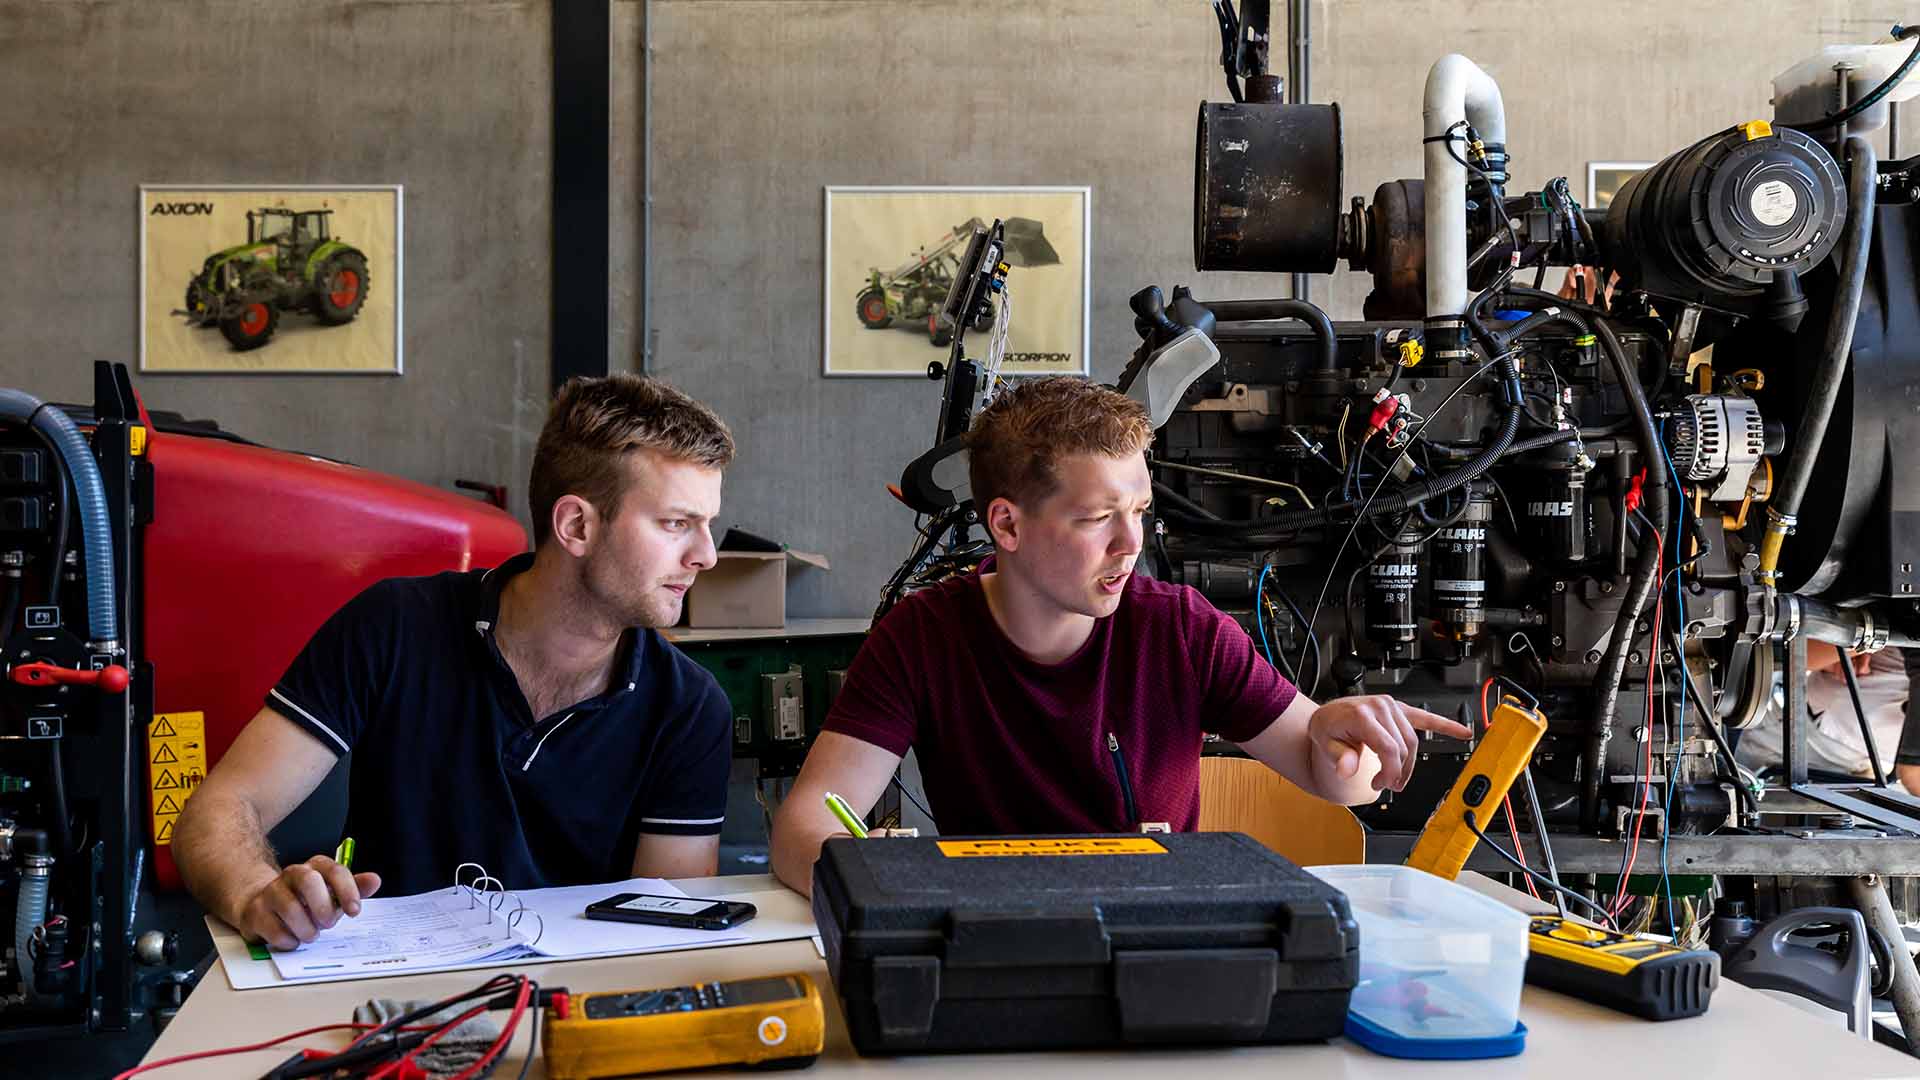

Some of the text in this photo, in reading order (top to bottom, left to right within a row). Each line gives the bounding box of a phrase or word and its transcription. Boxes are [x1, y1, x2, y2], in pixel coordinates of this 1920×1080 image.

[150, 202, 214, 216] AXION
[1003, 352, 1072, 362] SCORPION
[1527, 501, 1574, 516] LAAS
[1437, 528, 1486, 540] CLAAS
[1370, 564, 1418, 576] CLAAS
[973, 840, 1122, 848] FLUKE
